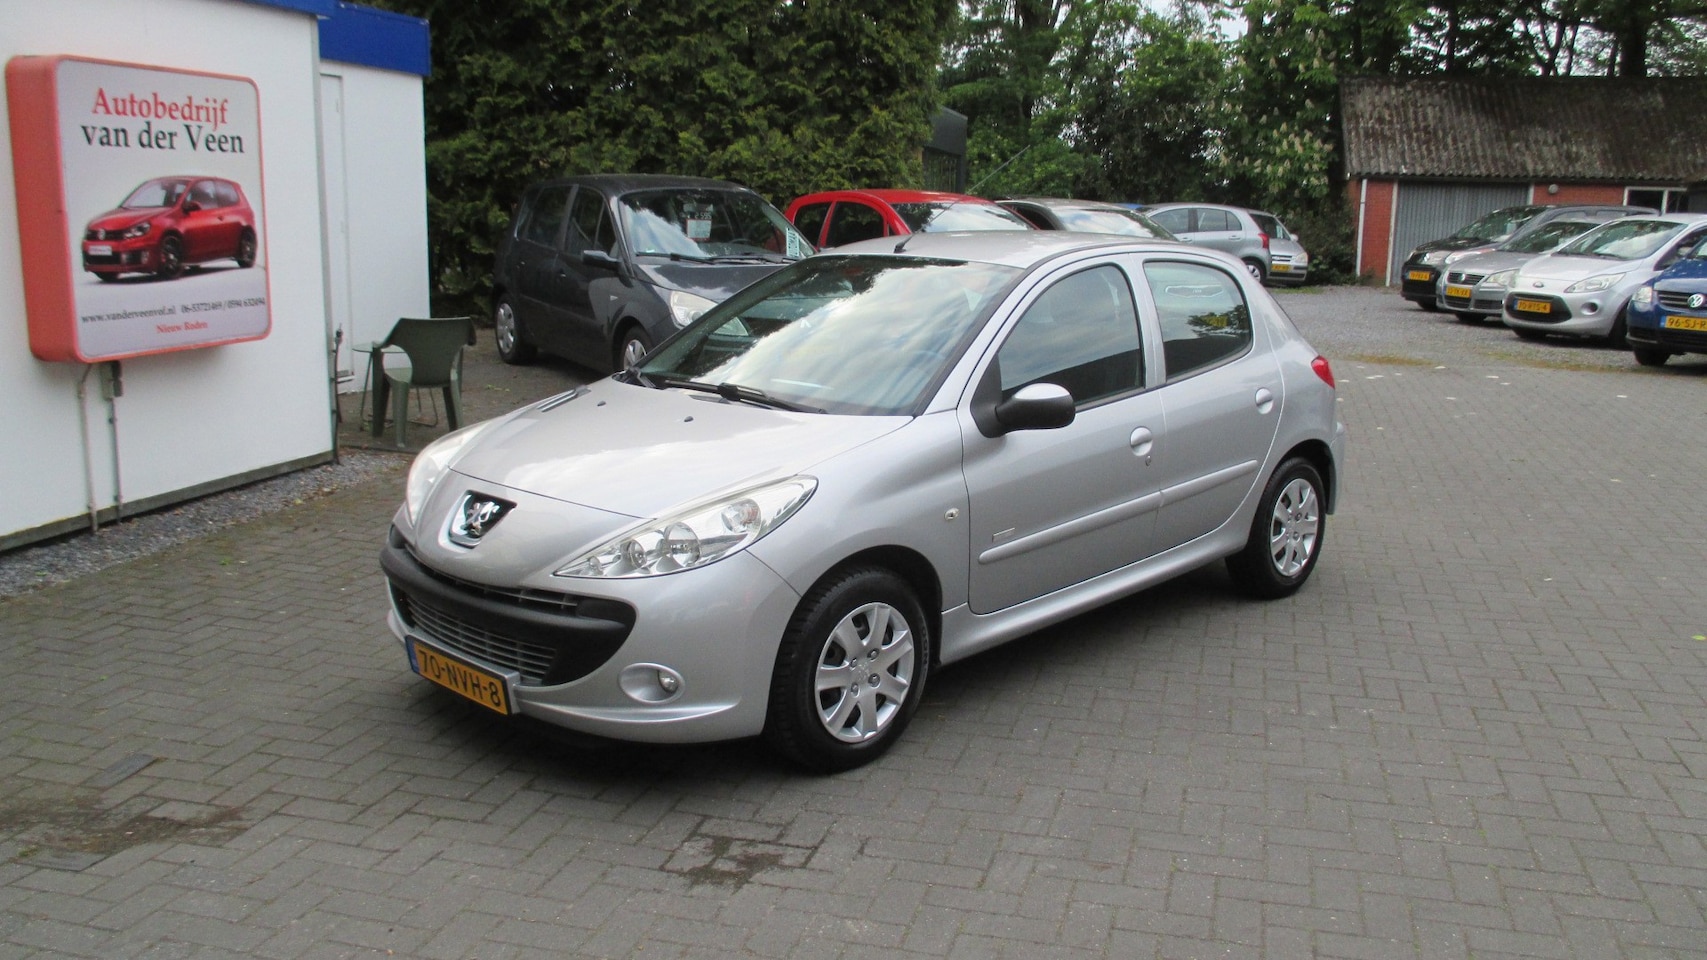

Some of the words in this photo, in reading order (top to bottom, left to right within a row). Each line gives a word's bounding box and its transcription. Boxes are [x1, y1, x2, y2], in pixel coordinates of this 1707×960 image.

[91, 87, 228, 131] Autobedrijf
[80, 124, 131, 148] van
[138, 120, 178, 150] der
[183, 123, 244, 153] Veen
[419, 649, 501, 707] 70-NVH-8
